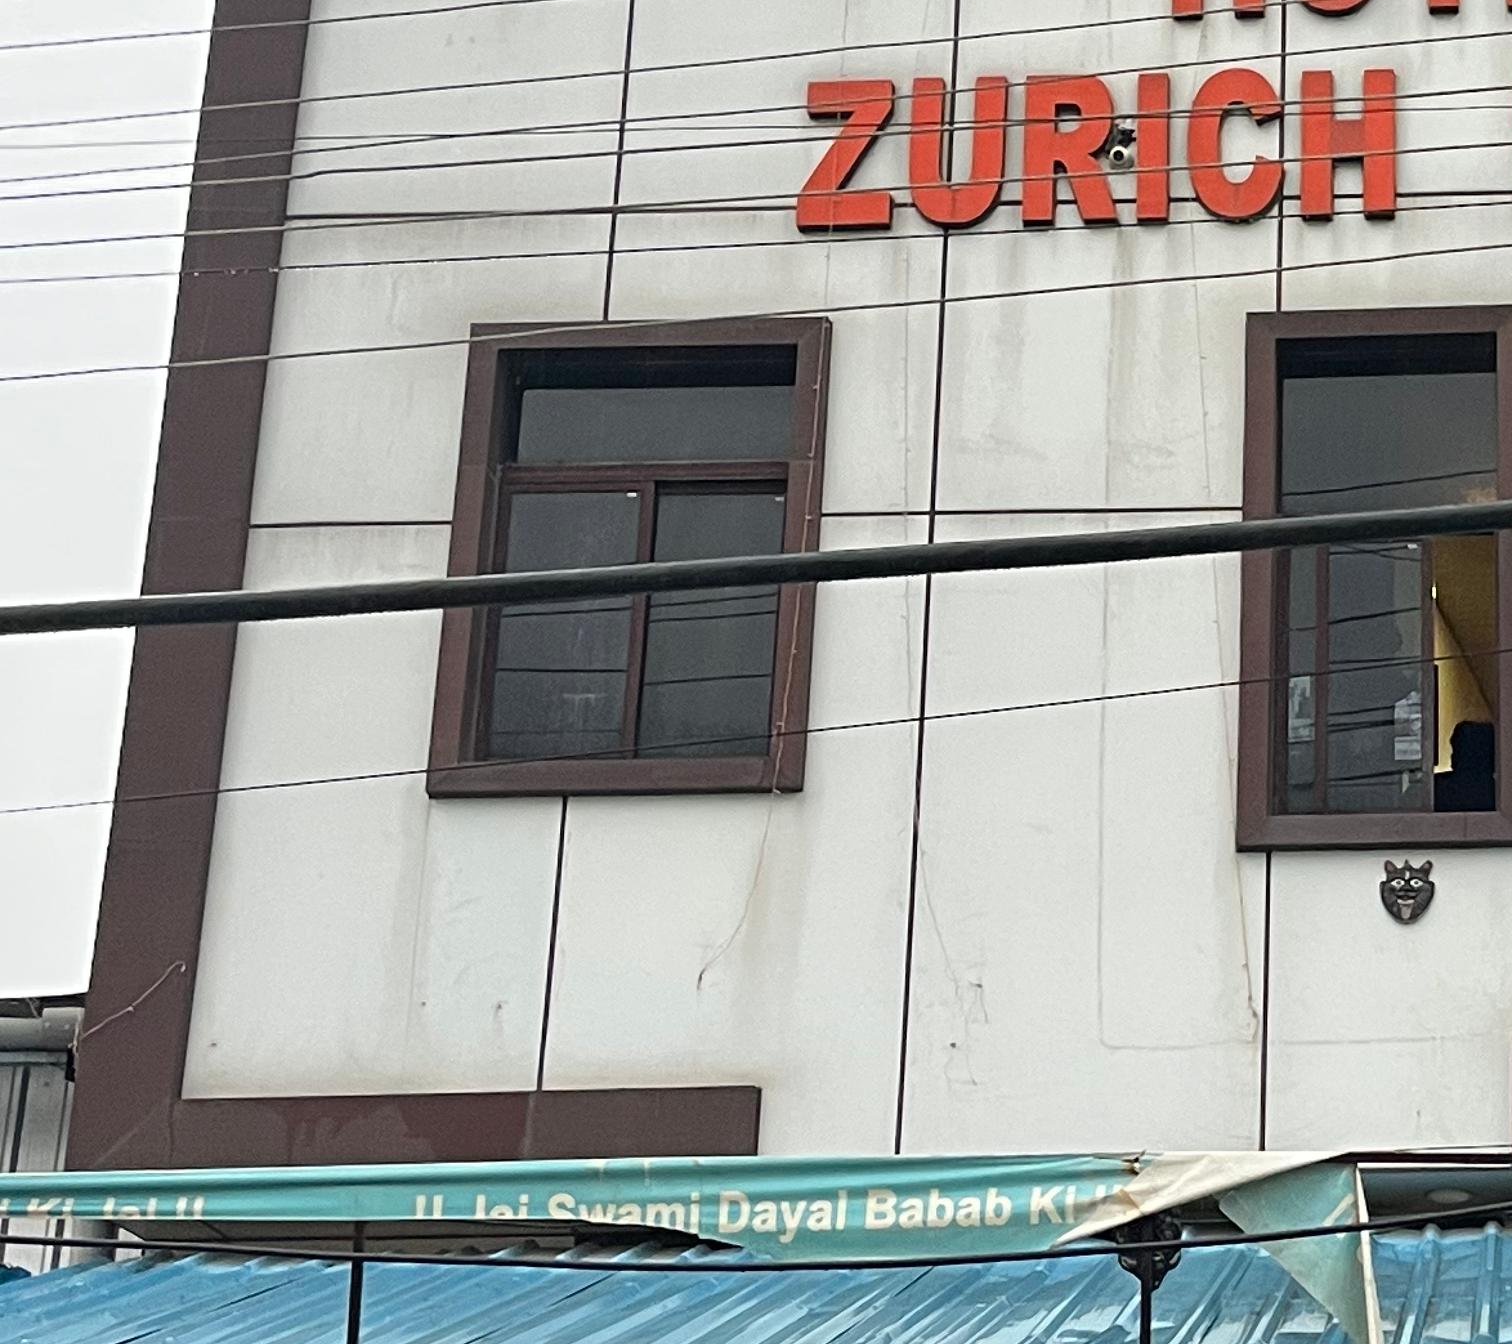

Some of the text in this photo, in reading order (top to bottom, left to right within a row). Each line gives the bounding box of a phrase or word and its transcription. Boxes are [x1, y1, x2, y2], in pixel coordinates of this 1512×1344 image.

[796, 66, 1397, 234] ZURICH
[716, 1189, 848, 1244] Dayal
[863, 1186, 1013, 1231] Babab
